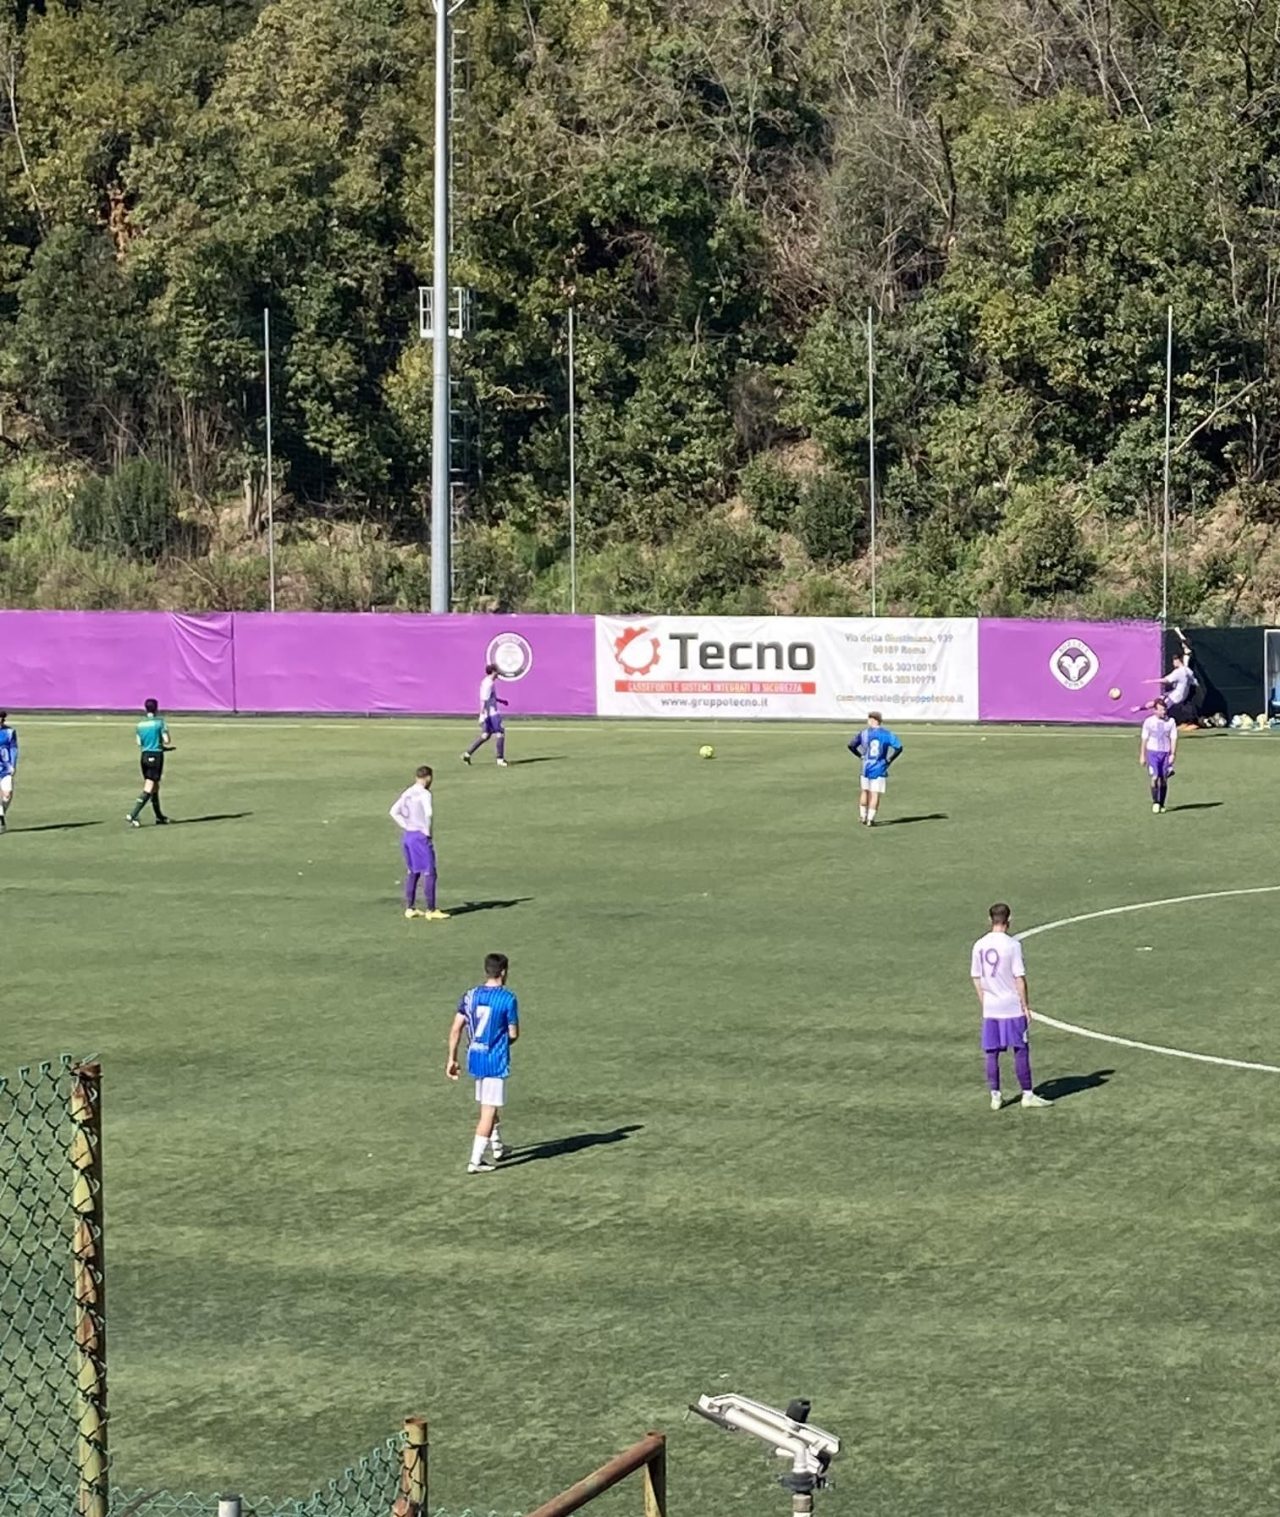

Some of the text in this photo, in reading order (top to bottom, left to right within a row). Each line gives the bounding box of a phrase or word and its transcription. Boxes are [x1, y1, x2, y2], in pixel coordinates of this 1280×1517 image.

[668, 632, 816, 671] Tecno
[901, 645, 926, 655] Roma
[863, 675, 881, 684] FAX
[660, 698, 768, 708] www.gruppotecno.it
[979, 948, 1000, 978] 19
[475, 1004, 491, 1038] 7
